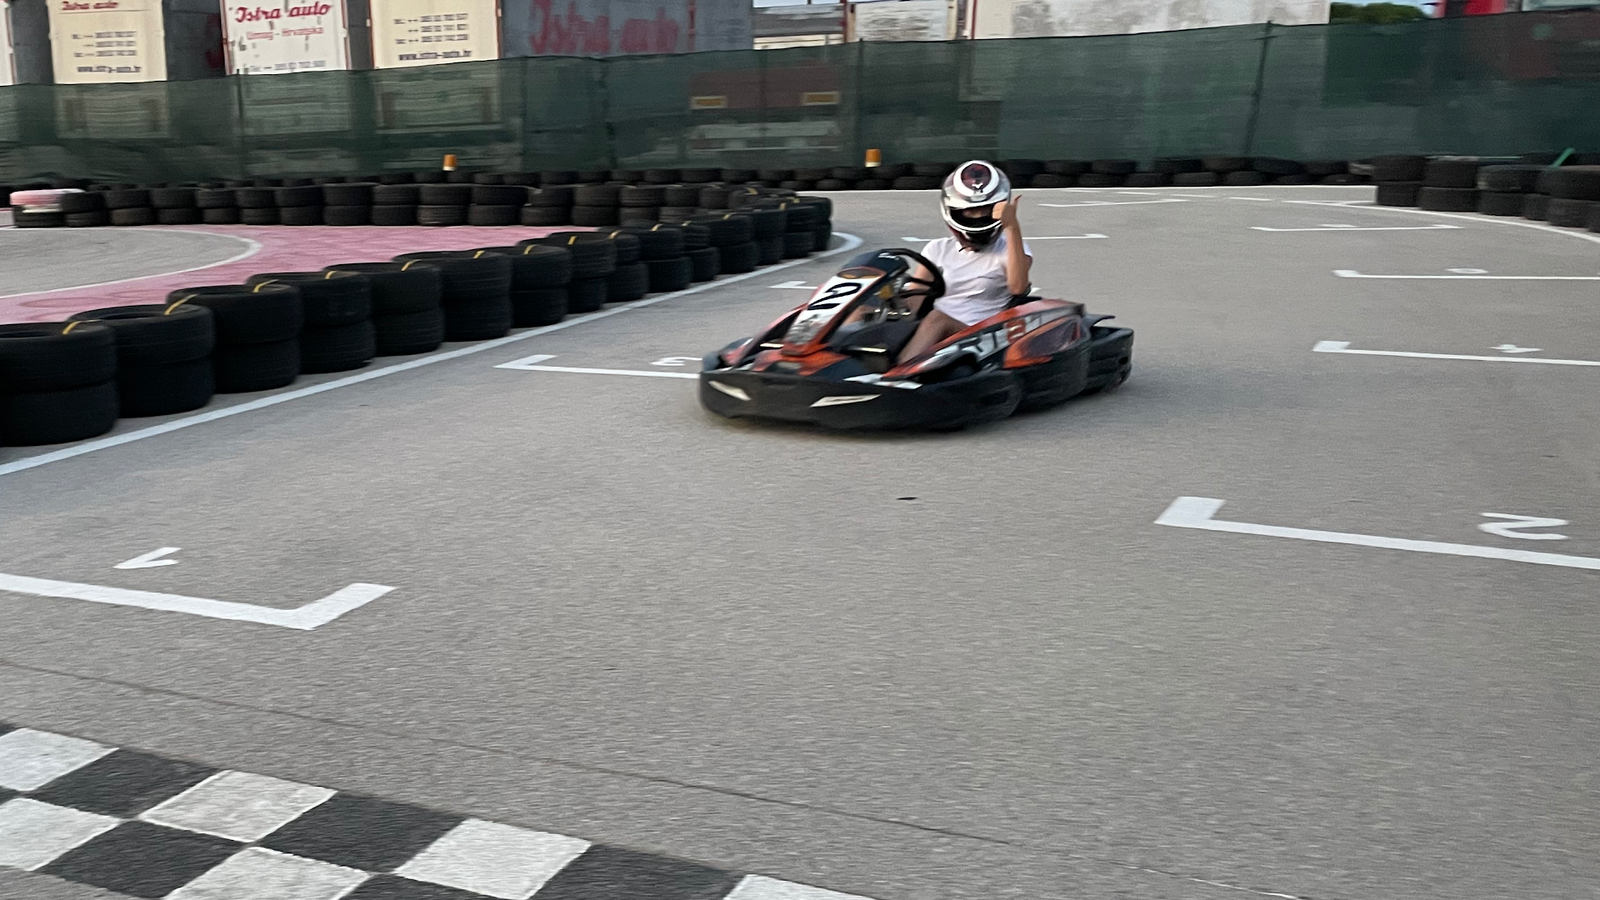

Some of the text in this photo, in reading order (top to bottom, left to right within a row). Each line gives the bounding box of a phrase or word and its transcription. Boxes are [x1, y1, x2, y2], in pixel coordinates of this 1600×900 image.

[235, 1, 331, 23] Istra auto
[807, 282, 863, 310] 2
